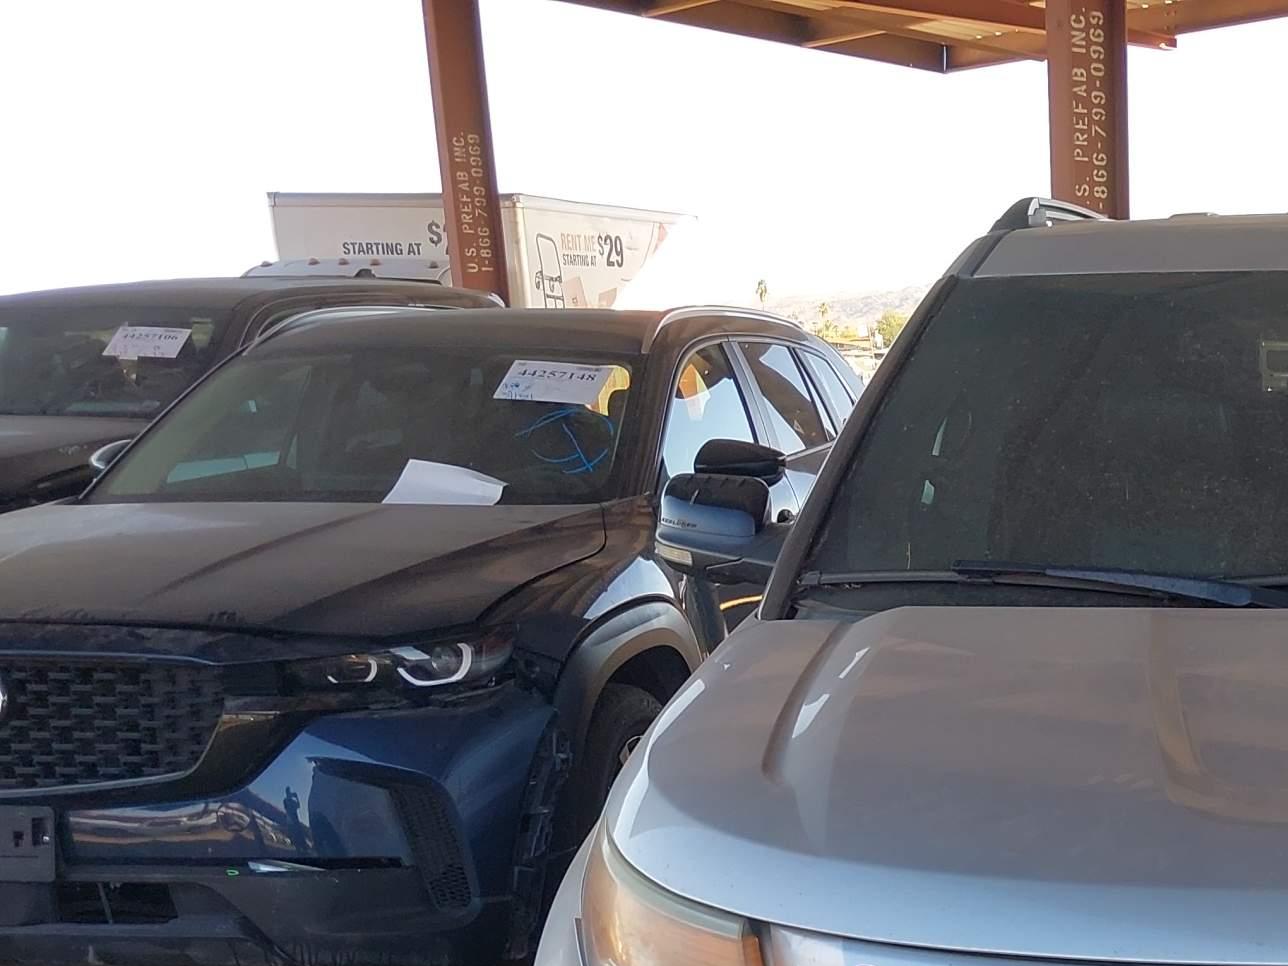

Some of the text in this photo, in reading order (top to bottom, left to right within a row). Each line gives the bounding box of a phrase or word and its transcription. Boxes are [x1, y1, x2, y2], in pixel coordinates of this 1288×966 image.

[1070, 7, 1086, 53] INC.
[1072, 67, 1089, 161] PREFAB
[1089, 11, 1108, 209] -866-799-0969
[452, 131, 479, 273] U.S. PREFAB INC.
[467, 133, 494, 272] 1-866-799-0969
[342, 241, 404, 256] STARTING
[407, 242, 422, 256] AT
[560, 232, 596, 252] RENT ME
[562, 253, 597, 267] STARTING AT
[597, 232, 623, 268] $29
[518, 369, 598, 381] 44257148
